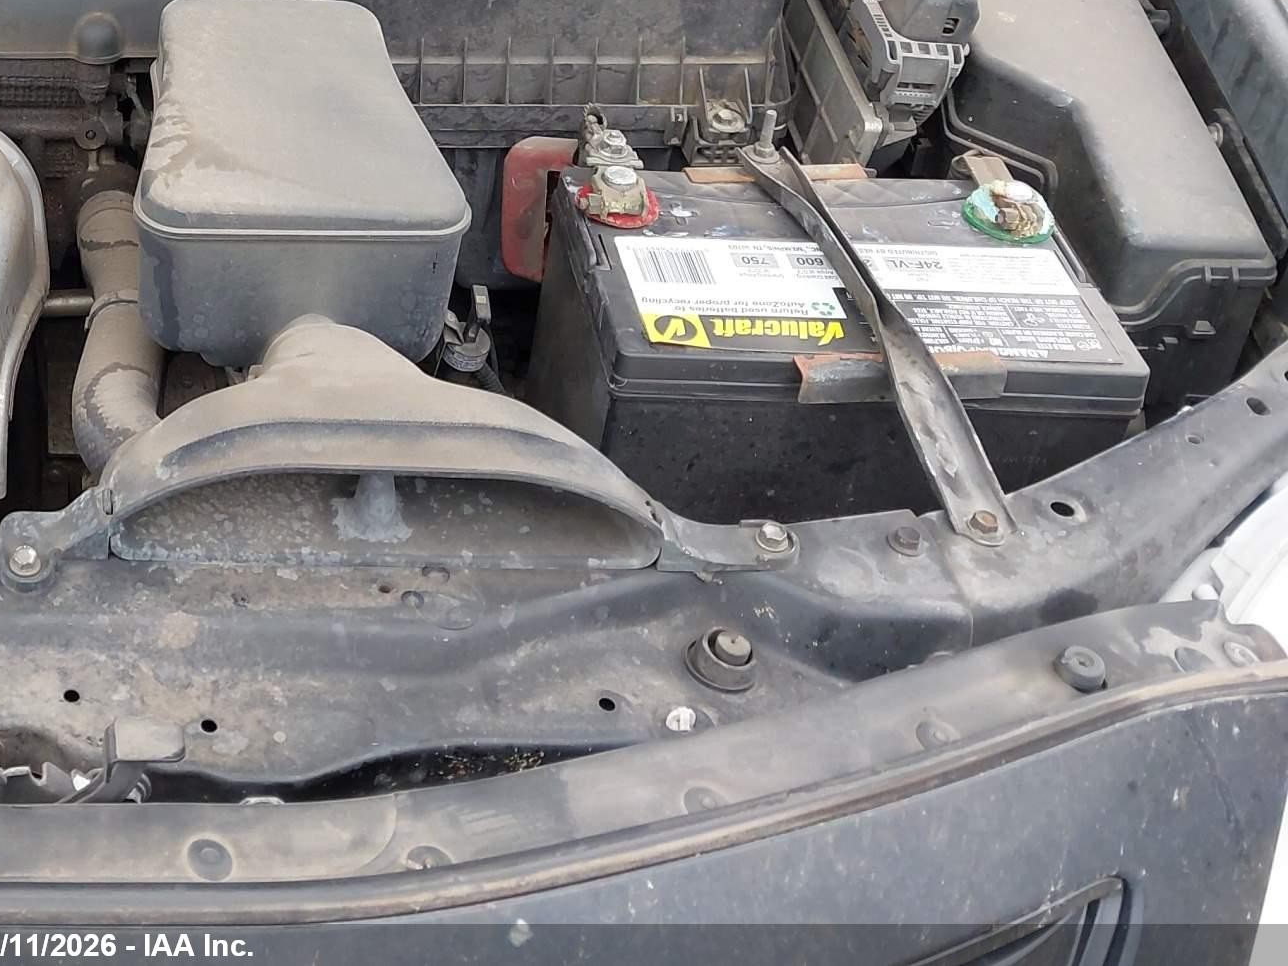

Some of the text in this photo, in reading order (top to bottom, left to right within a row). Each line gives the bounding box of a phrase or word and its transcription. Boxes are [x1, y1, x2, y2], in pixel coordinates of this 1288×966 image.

[741, 256, 769, 265] 750
[796, 257, 824, 266] 600
[887, 260, 943, 269] 24F-VL
[641, 297, 690, 305] recycling
[771, 308, 809, 316] Return
[710, 318, 844, 346] Valucraft
